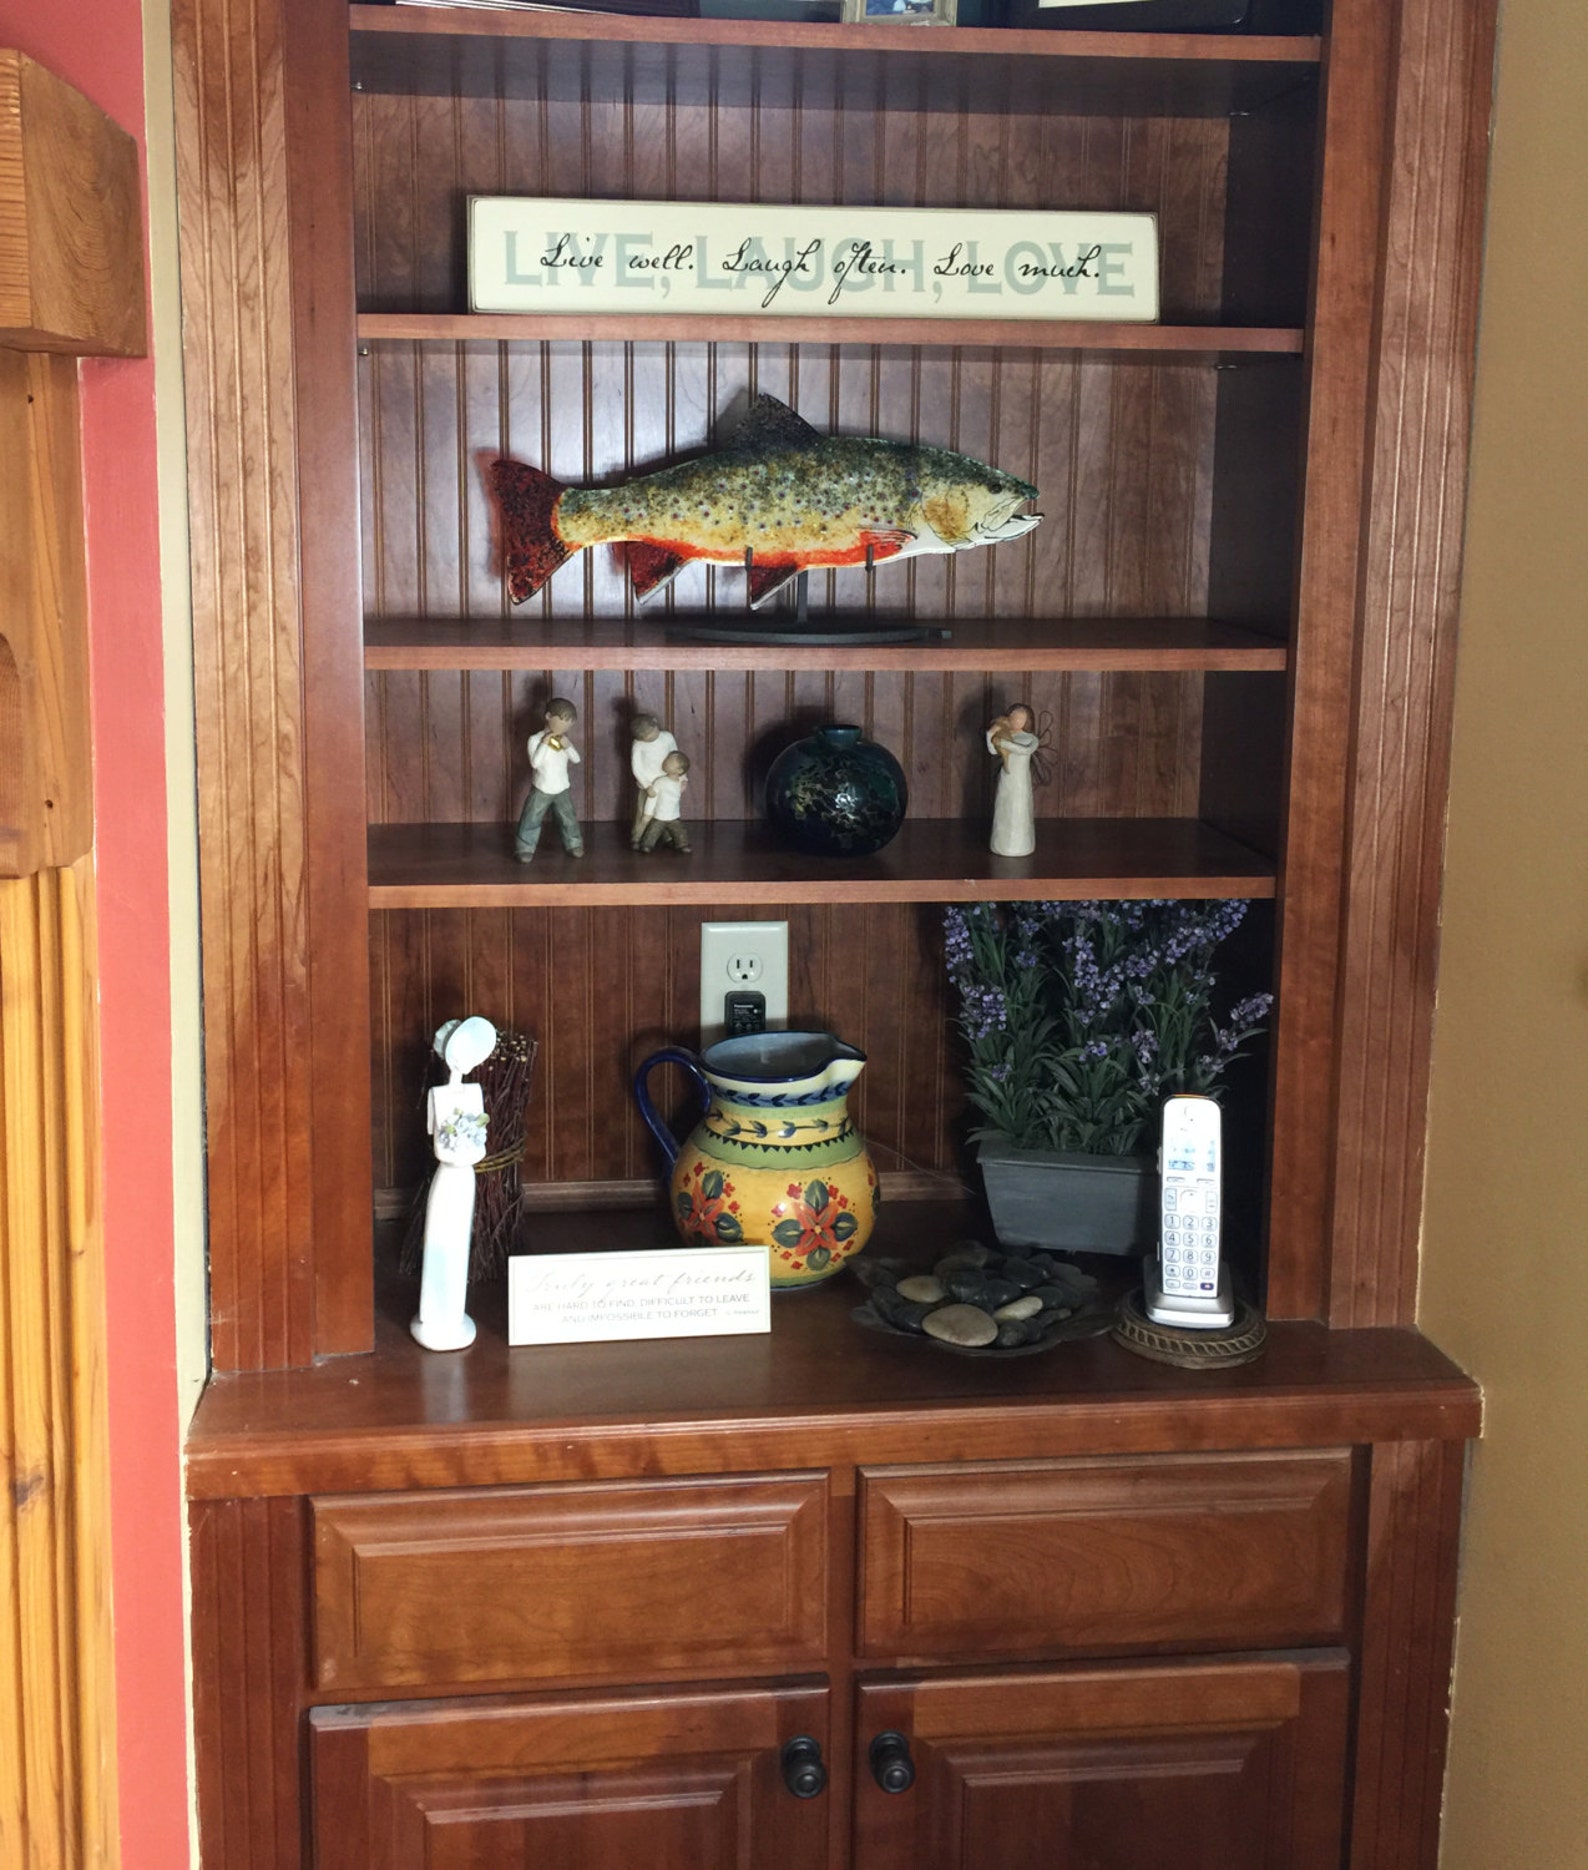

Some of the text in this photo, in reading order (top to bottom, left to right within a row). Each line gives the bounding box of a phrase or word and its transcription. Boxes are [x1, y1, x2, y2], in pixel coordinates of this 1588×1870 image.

[540, 233, 1102, 308] Live well. Laugh often. Love much.
[966, 240, 1135, 297] LOVE
[666, 1269, 757, 1295] friends
[640, 1296, 696, 1307] DIFFICULT
[699, 1295, 714, 1305] TO
[716, 1293, 751, 1304] LEAVE
[657, 1310, 672, 1319] TO
[674, 1308, 718, 1319] FORGET
